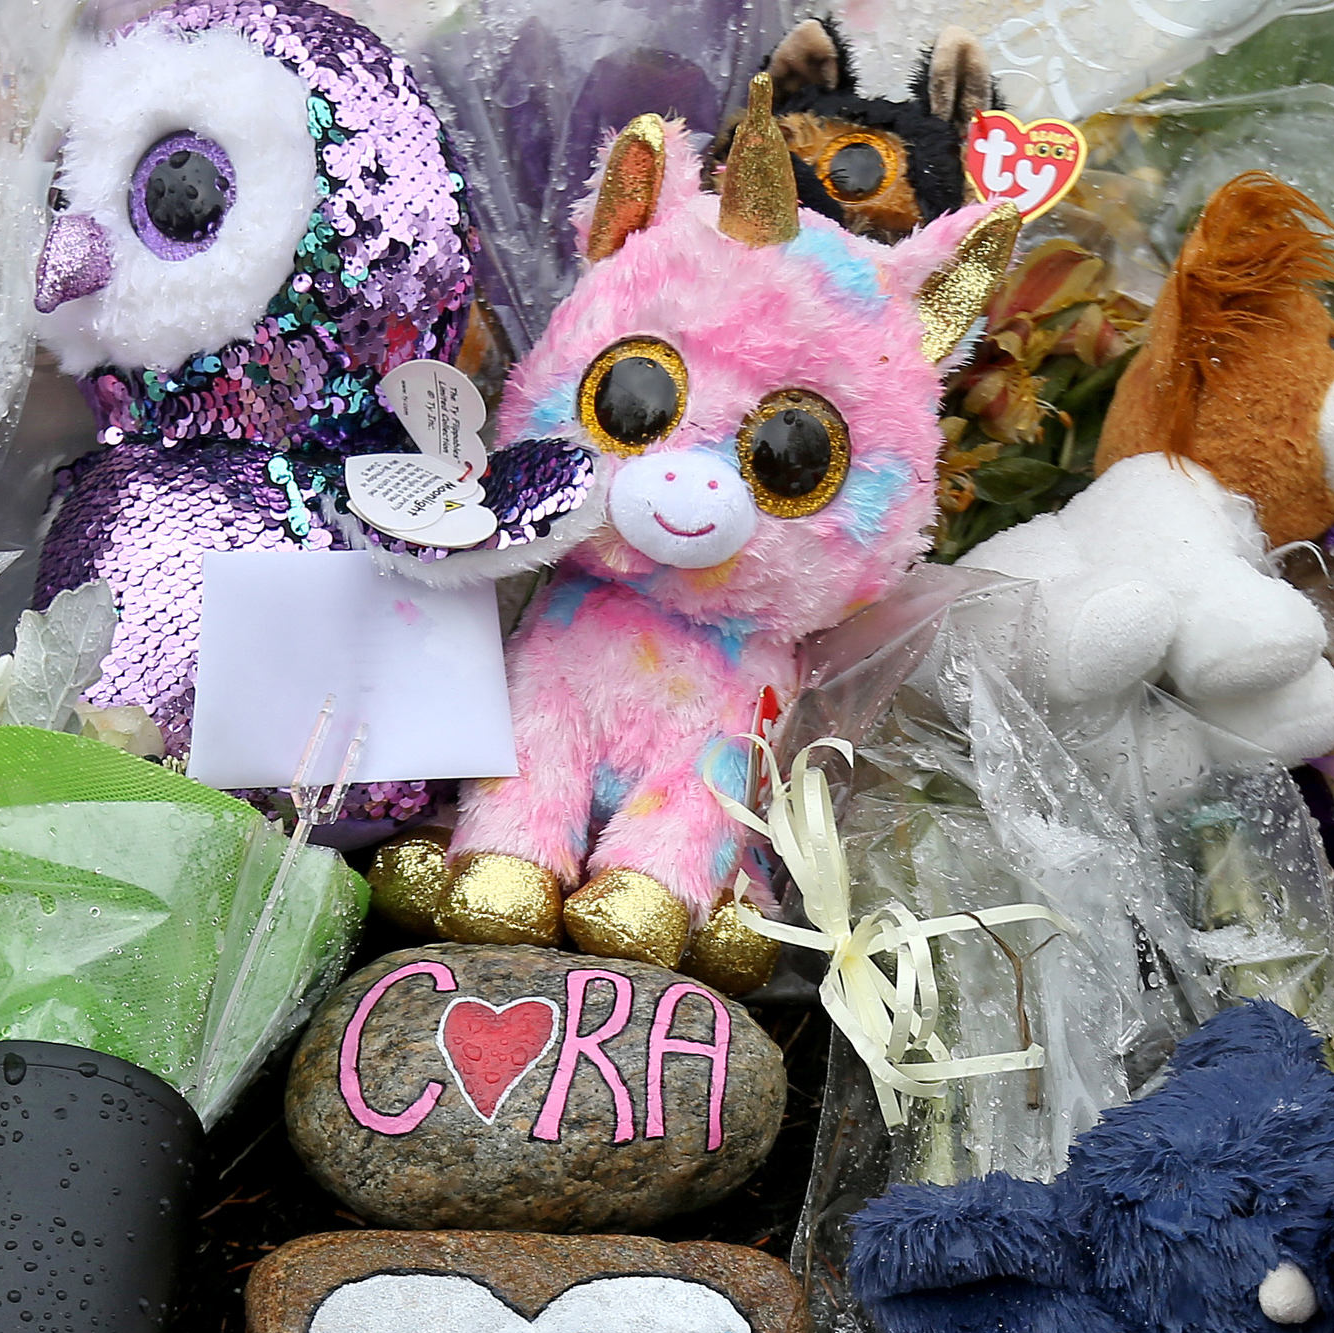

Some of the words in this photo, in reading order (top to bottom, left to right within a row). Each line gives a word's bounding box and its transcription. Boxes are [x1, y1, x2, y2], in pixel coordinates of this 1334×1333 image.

[974, 129, 1057, 212] ty
[425, 402, 435, 412] Ty
[438, 381, 447, 410] Limited
[427, 413, 435, 430] Inc.
[450, 406, 458, 416] Ty
[408, 481, 456, 516] Moonlight
